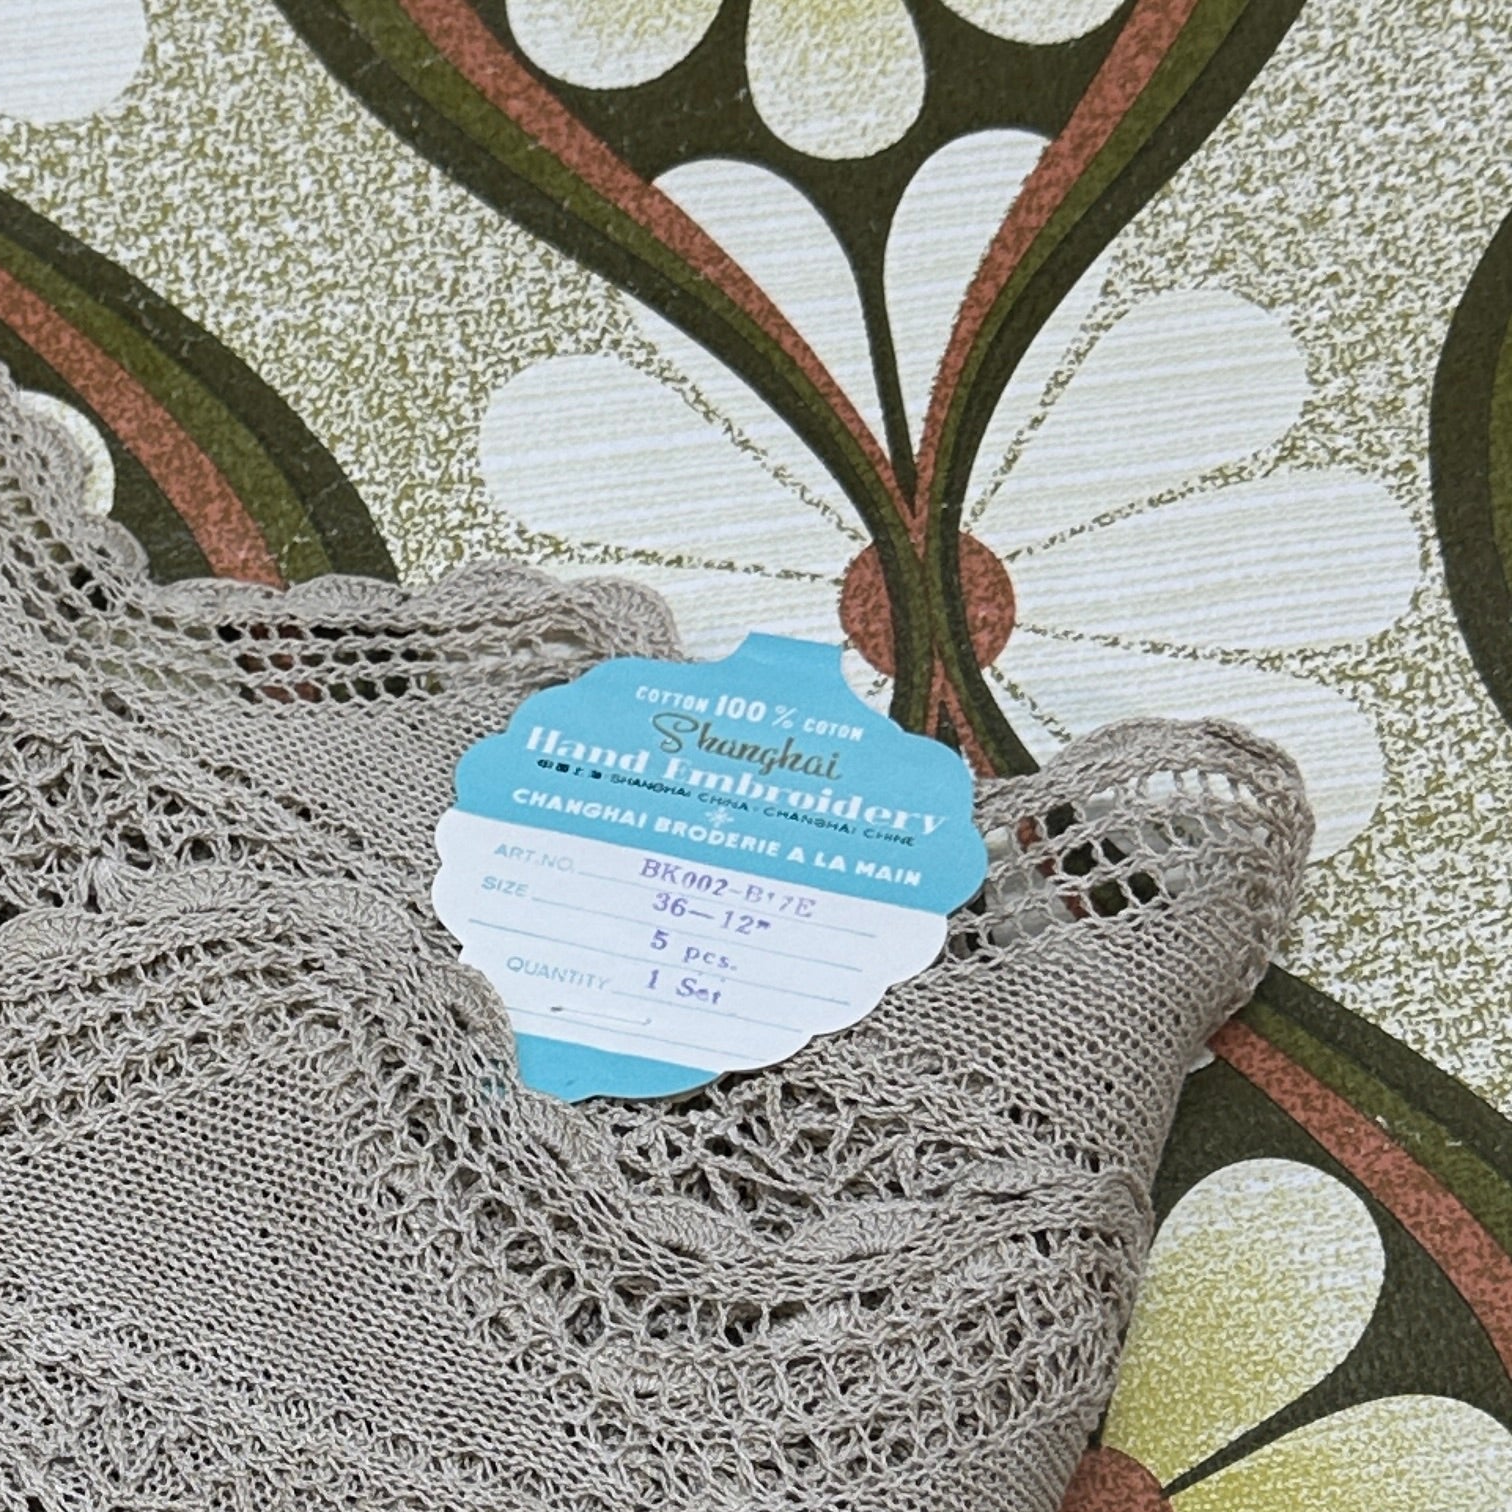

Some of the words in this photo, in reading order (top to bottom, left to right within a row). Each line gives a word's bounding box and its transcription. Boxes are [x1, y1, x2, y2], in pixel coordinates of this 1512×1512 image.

[635, 685, 710, 713] COTTON
[714, 694, 767, 723] 100
[802, 717, 864, 742] COTON
[651, 711, 843, 781] Shanghai
[526, 726, 650, 774] Hand
[662, 757, 947, 835] Embroidery
[512, 787, 648, 829] CHANGHAI
[654, 816, 781, 858] BRODERIE
[786, 847, 806, 864] A
[814, 852, 847, 873] LA
[855, 860, 922, 887] MAIN
[481, 876, 529, 898] SIZE
[650, 929, 670, 951] 5
[506, 956, 609, 990] QUANTITY
[647, 969, 660, 989] 1
